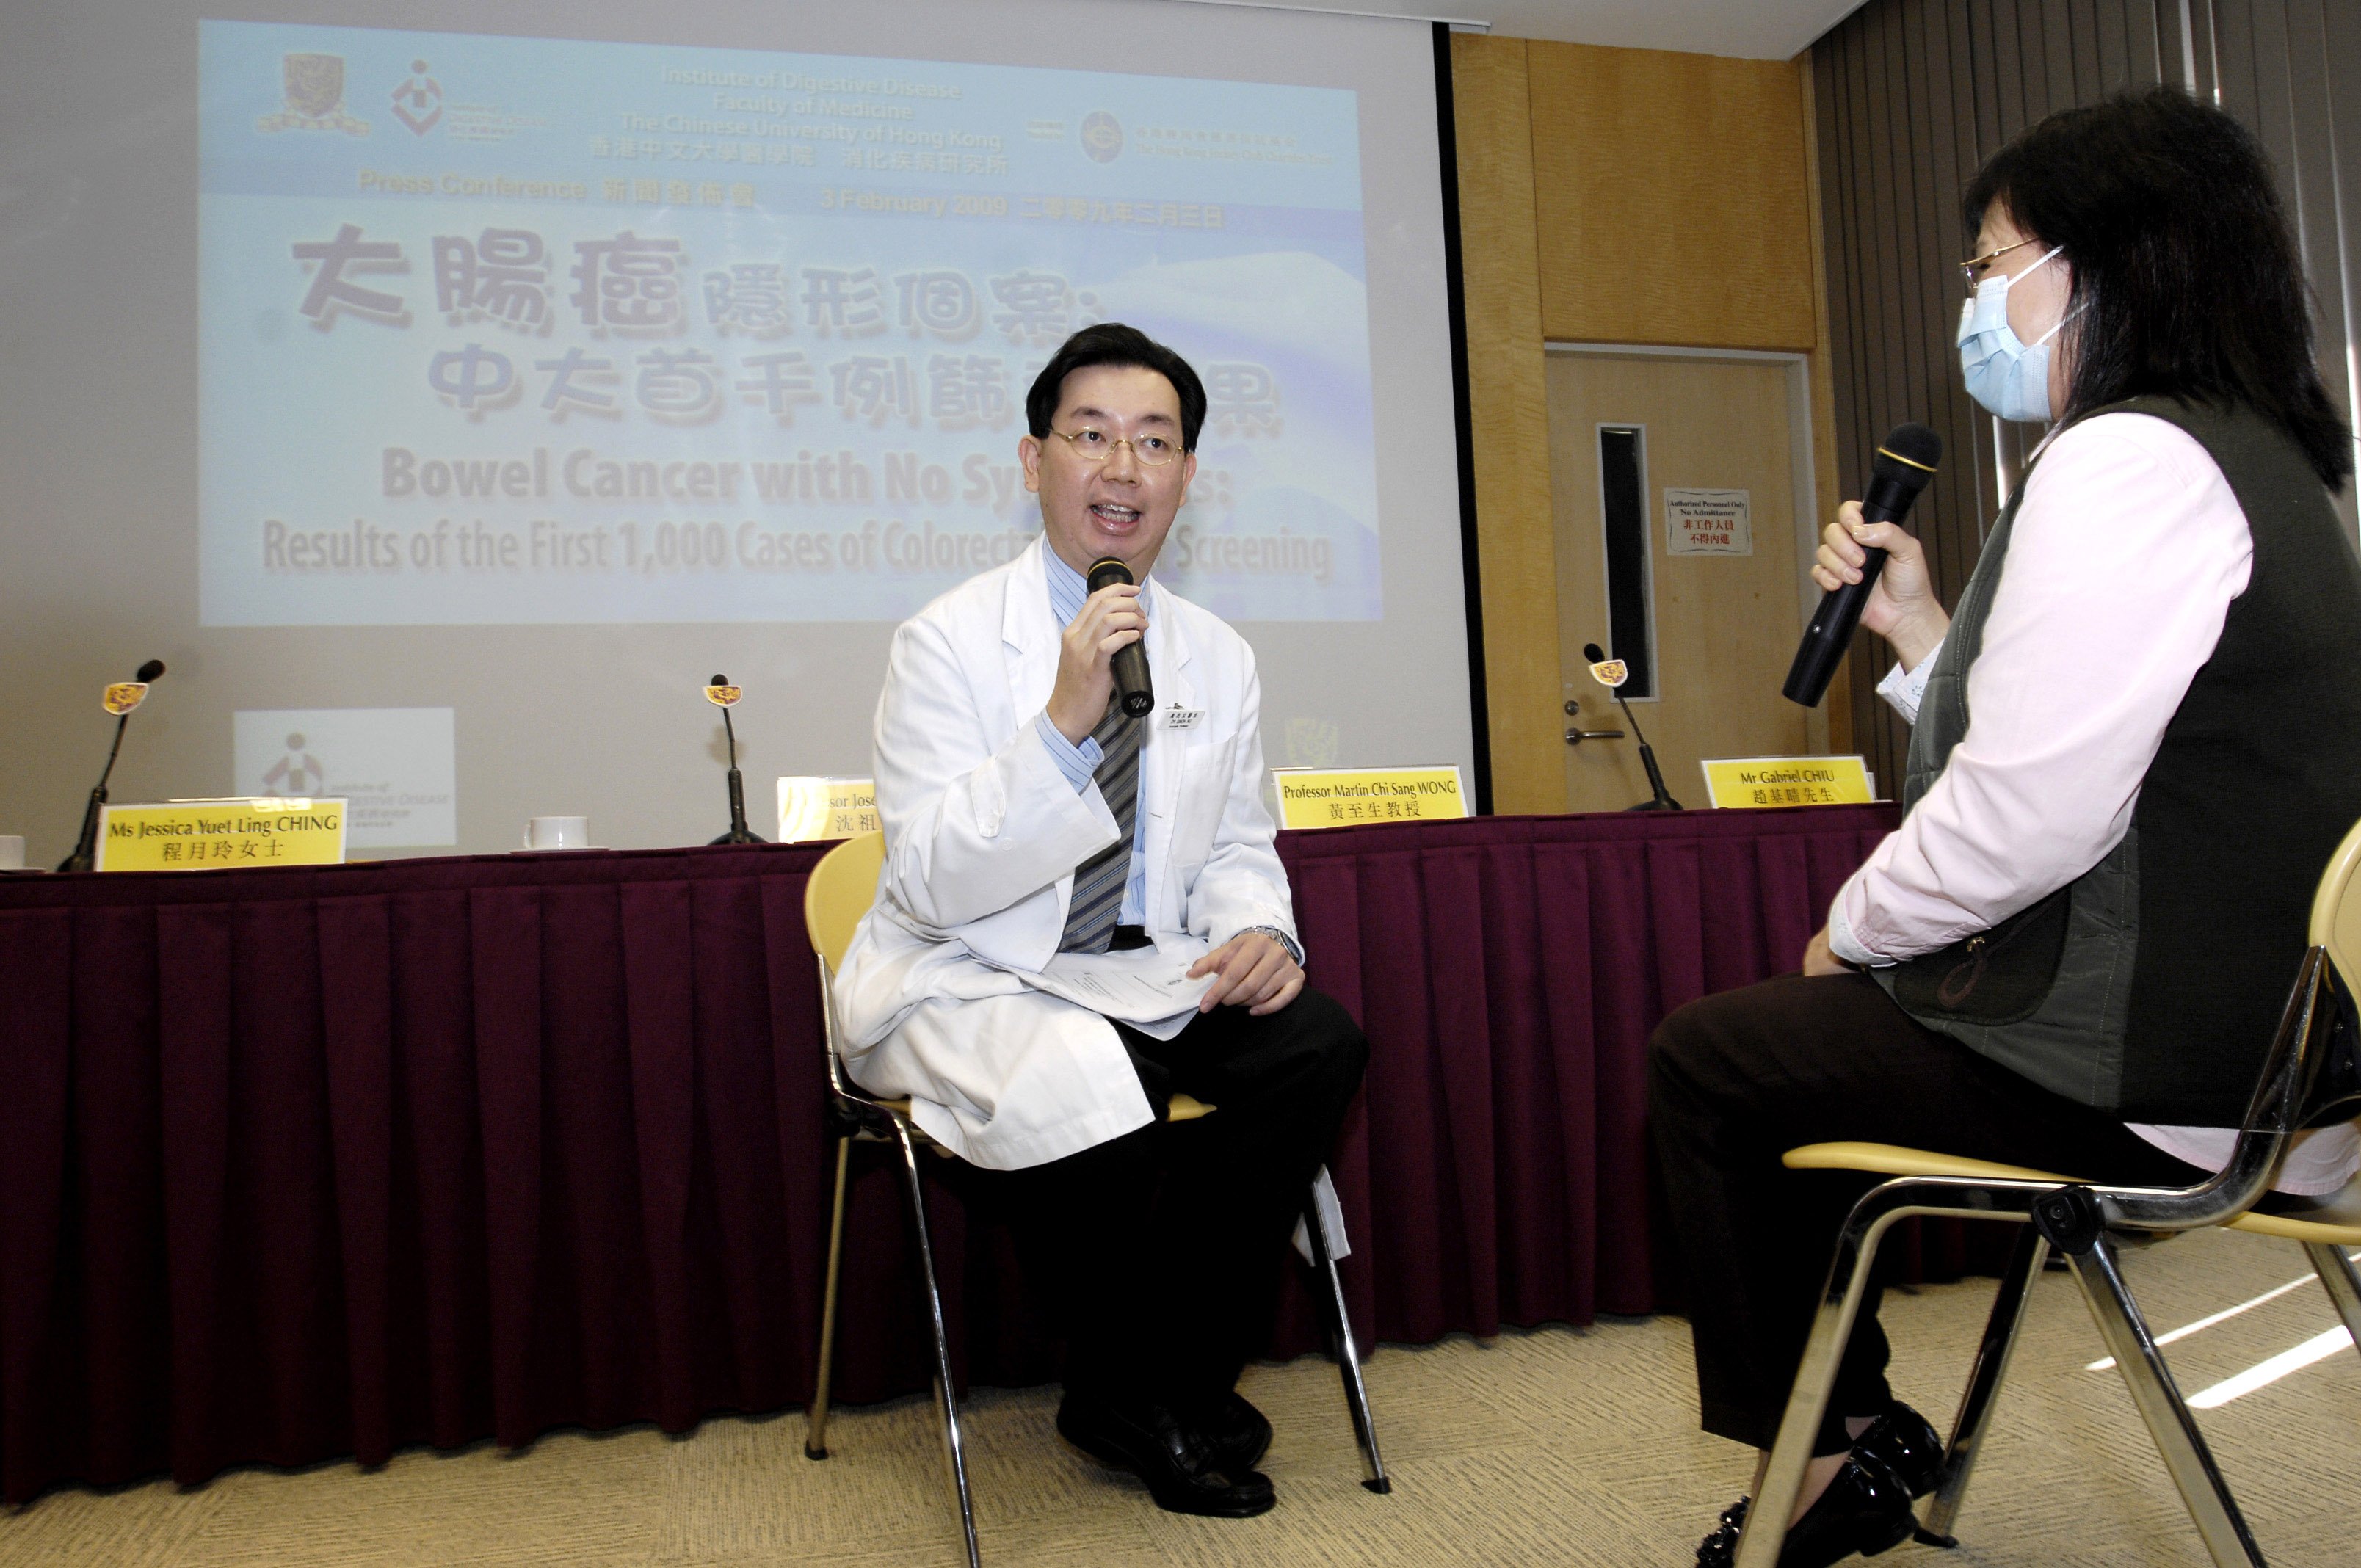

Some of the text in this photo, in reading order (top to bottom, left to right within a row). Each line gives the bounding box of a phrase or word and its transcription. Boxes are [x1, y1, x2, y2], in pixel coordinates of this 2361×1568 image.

[662, 65, 962, 100] Institute of Digestive Disease
[712, 92, 914, 122] Faculty of Medicine
[622, 112, 658, 132] The
[664, 114, 750, 137] Chinese
[753, 117, 859, 145] University
[863, 124, 888, 142] of
[889, 128, 944, 149] Hong
[949, 131, 1003, 152] Kong
[841, 148, 1010, 177] 消化疾病研究所
[358, 167, 587, 203] Press Conference
[820, 188, 1009, 217] 3 February 2009
[1022, 196, 1225, 229] 二零零九年二月三日
[382, 446, 548, 501] Bowel
[562, 448, 739, 501] Cancer
[751, 449, 871, 503] with
[884, 451, 953, 504] No
[1730, 501, 1745, 509] Only
[1683, 519, 1735, 531] 非工作人員
[263, 518, 399, 570] Results
[409, 518, 450, 570] of
[455, 519, 519, 570] the
[530, 520, 609, 570] First
[617, 520, 728, 574] 1,000
[736, 520, 832, 570] Cases
[838, 518, 879, 569] of
[1175, 523, 1331, 581] Screening
[1285, 780, 1457, 799] Professor Martin Chi Sang WONG
[1741, 769, 1835, 785] Mr Gabriel CHIU
[1328, 800, 1422, 821] 黃至生教授
[109, 821, 134, 838] Ms
[139, 819, 193, 839] Jessica
[197, 818, 233, 835] Yuet
[238, 816, 272, 838] Ling
[277, 814, 338, 832] CHING
[162, 838, 284, 863] 程月玲女士
